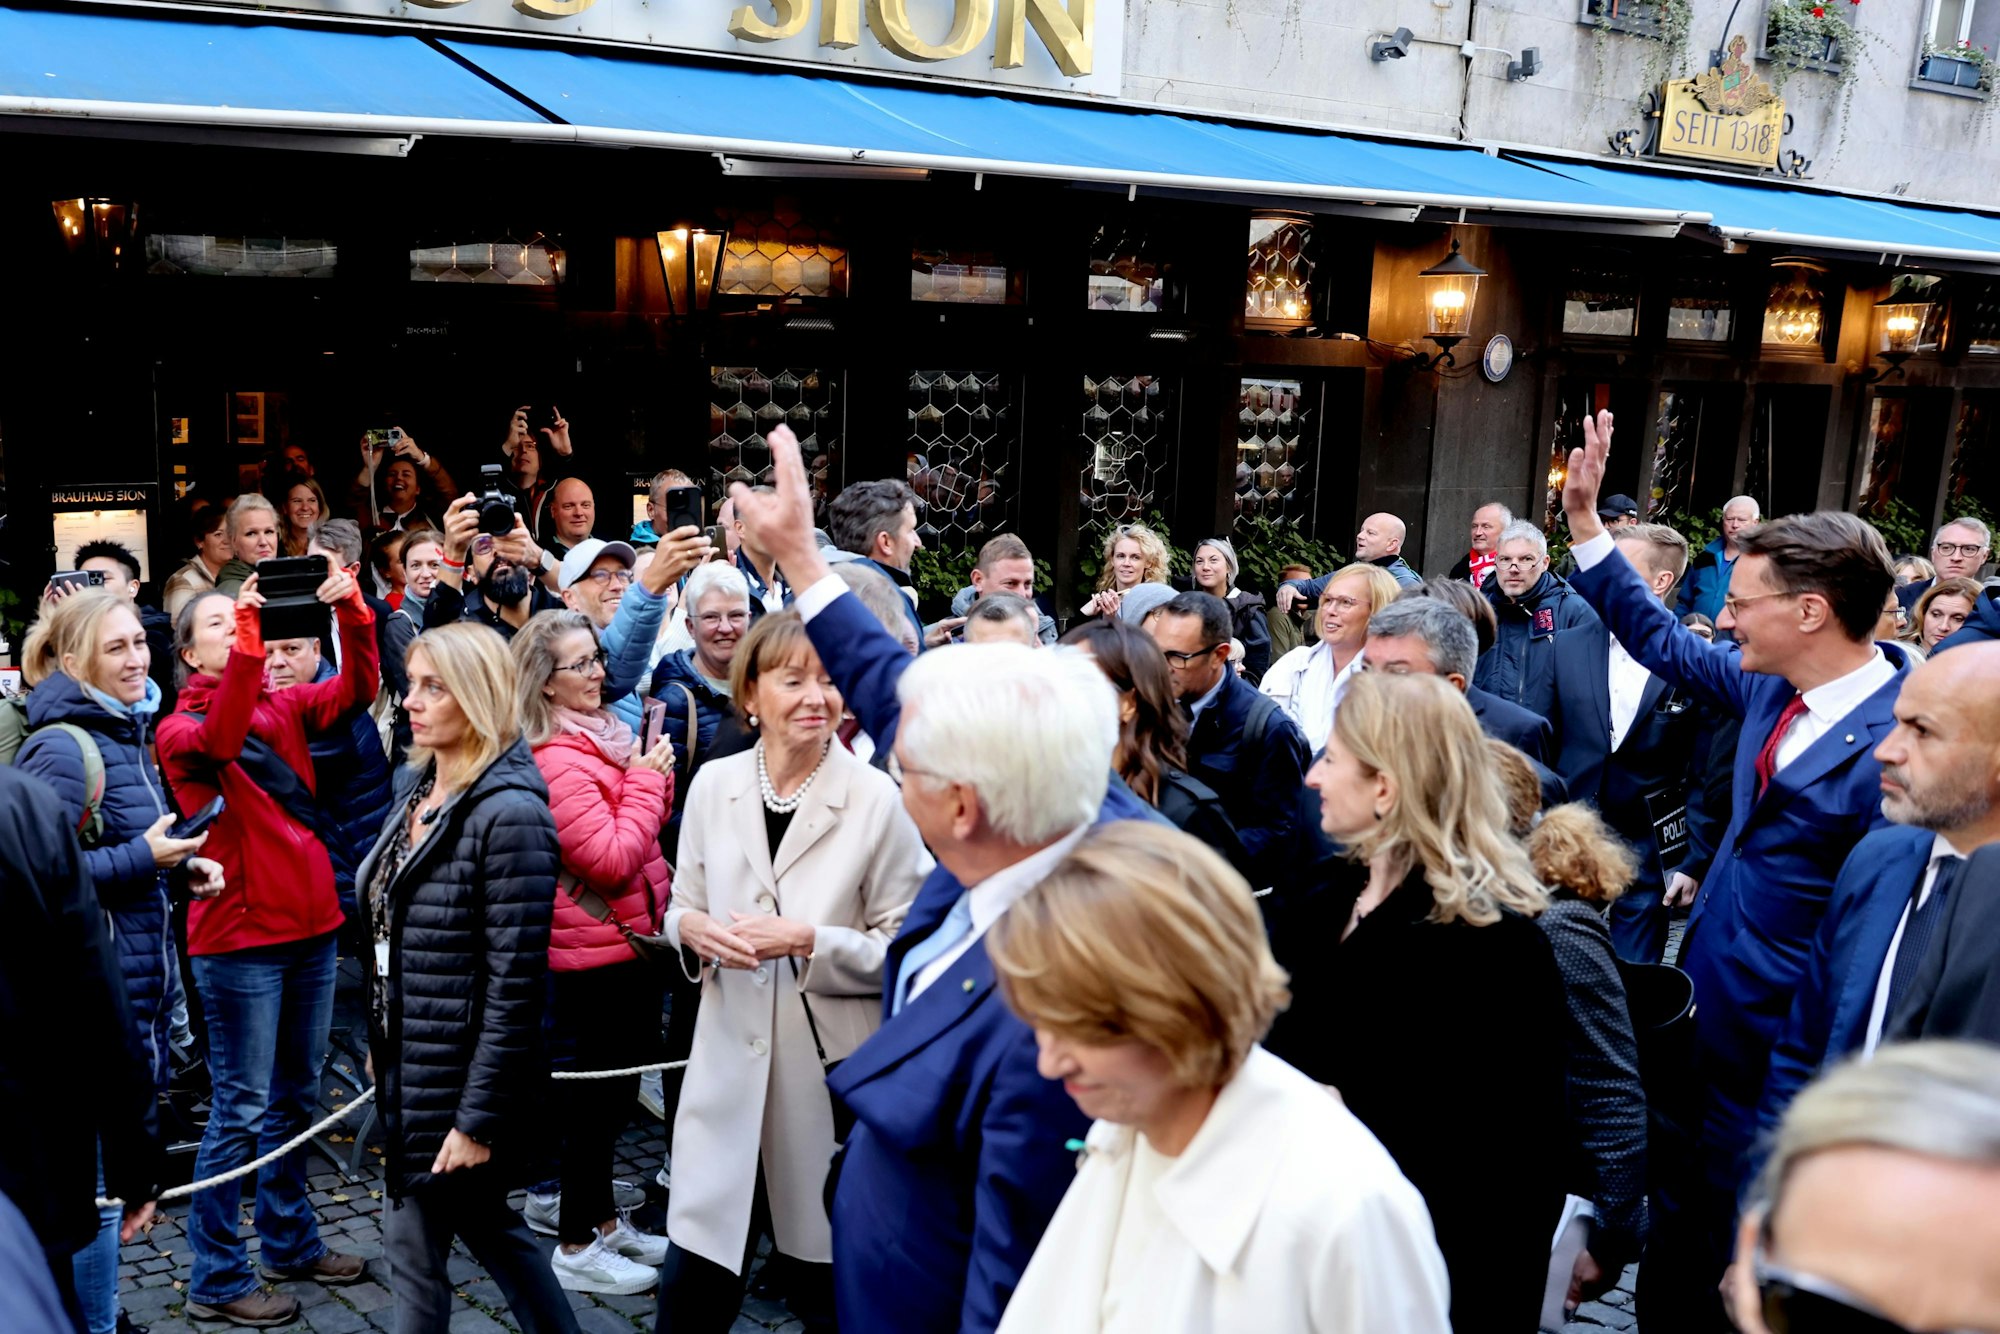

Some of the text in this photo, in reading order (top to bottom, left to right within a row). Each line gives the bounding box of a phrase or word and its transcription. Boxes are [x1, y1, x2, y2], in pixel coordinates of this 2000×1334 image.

[1672, 110, 1771, 155] SEIT 1318
[51, 489, 146, 503] BRAUHAUS SION
